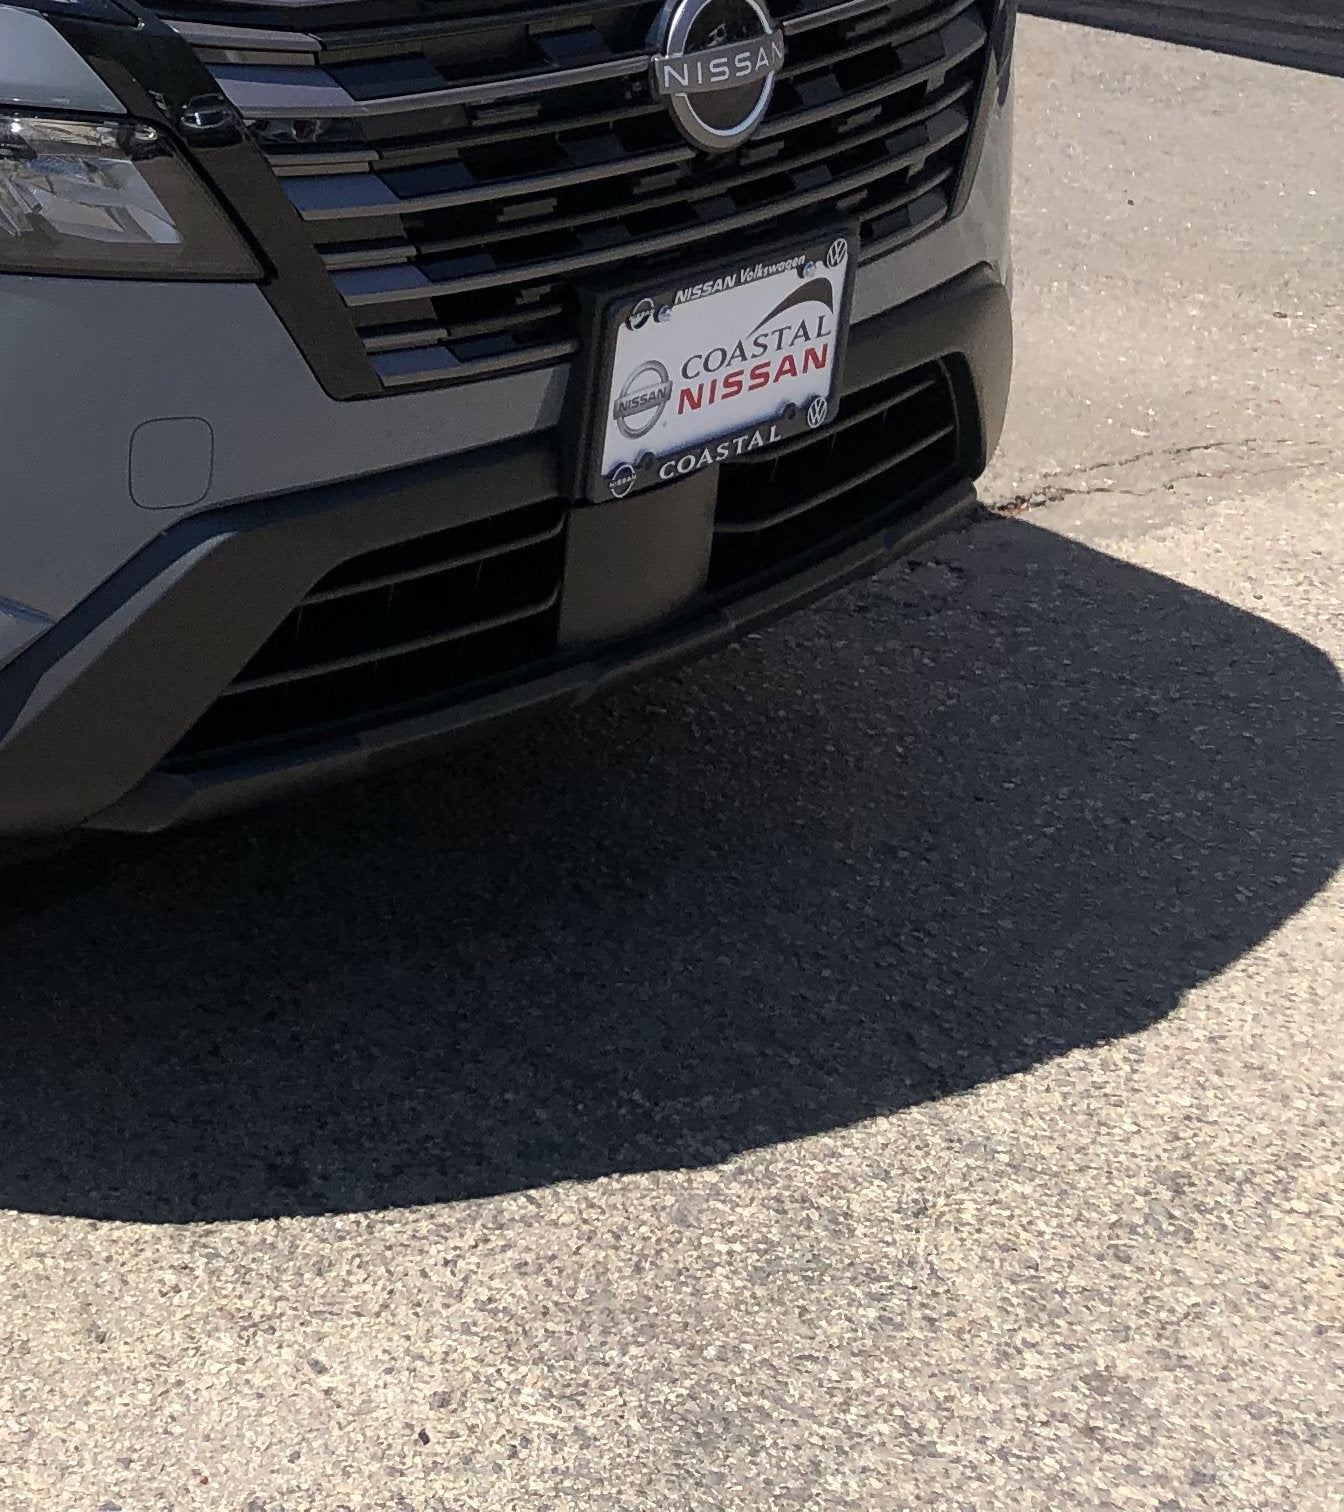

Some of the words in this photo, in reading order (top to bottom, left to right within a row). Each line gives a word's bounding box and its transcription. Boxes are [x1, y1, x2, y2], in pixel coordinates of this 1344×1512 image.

[663, 40, 784, 88] NISSAN
[674, 273, 737, 305] NISSAN
[739, 254, 806, 283] Volkswagen
[681, 314, 832, 381] COASTAL
[618, 385, 667, 412] NISSAN
[677, 343, 829, 416] NISSAN
[658, 424, 782, 481] COASTAL
